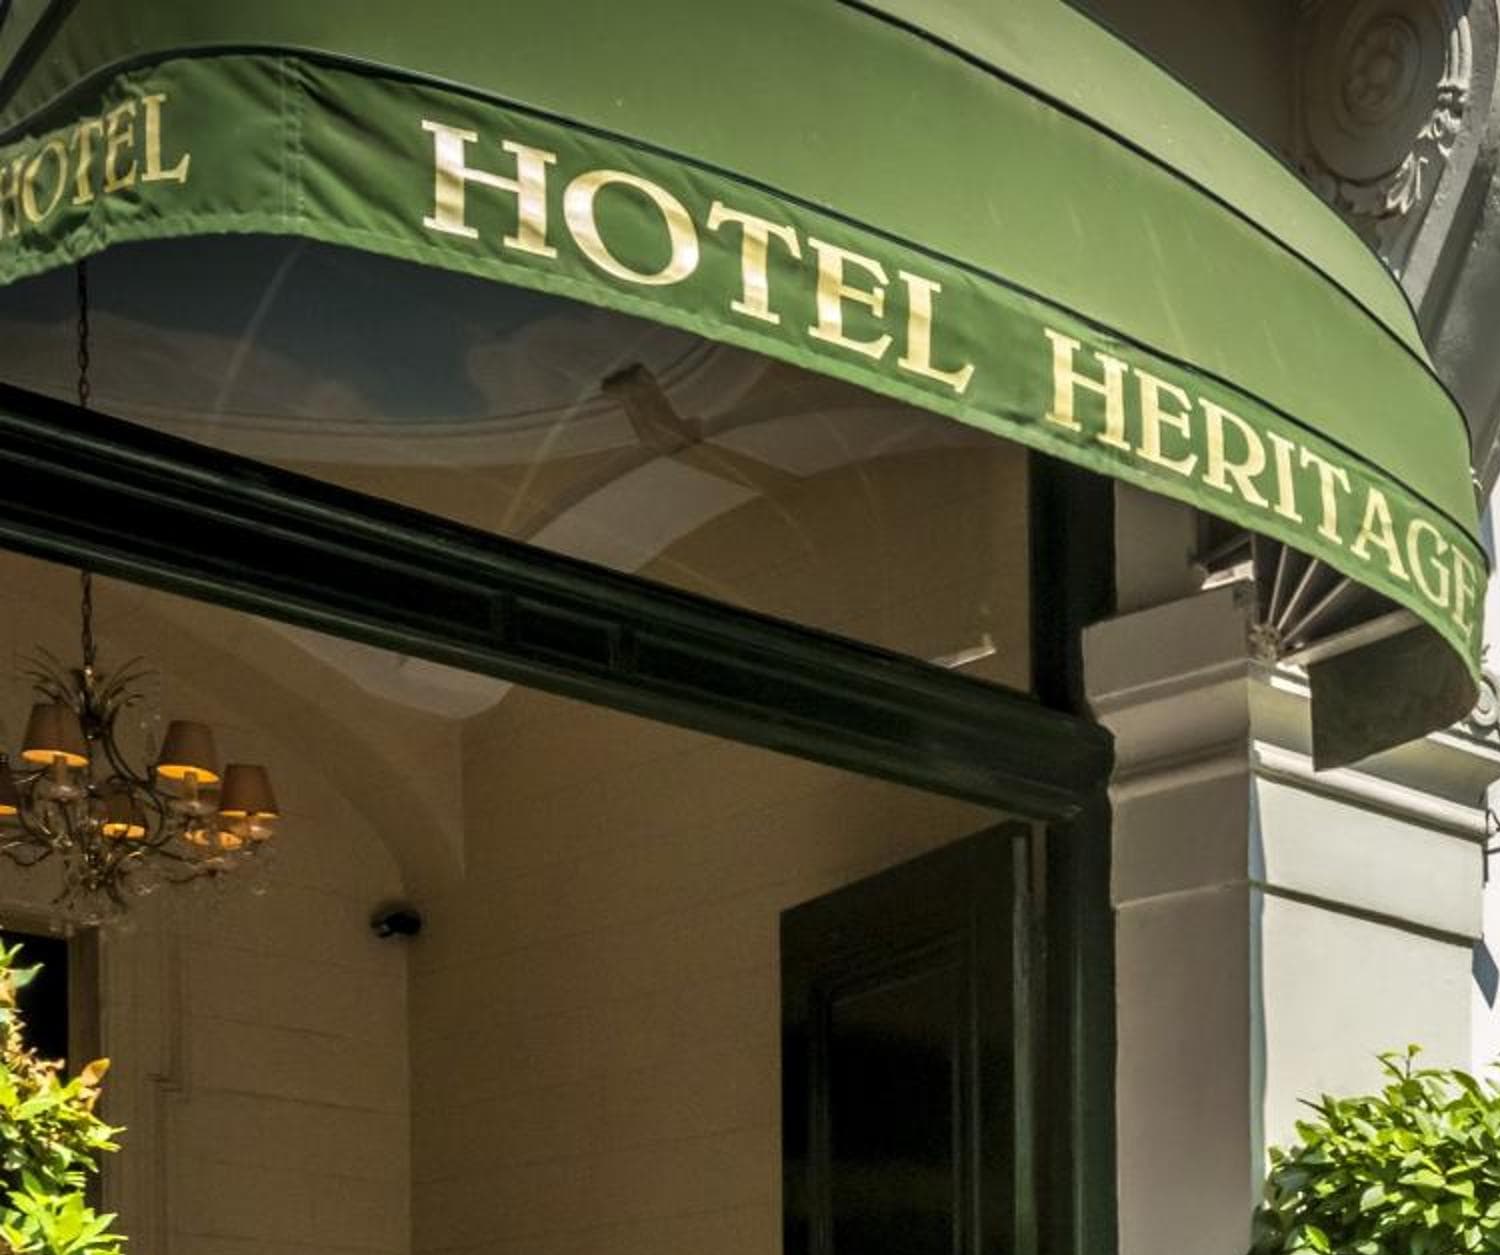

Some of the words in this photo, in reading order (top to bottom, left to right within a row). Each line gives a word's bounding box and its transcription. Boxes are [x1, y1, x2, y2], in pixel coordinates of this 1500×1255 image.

[0, 93, 191, 240] HOTEL
[420, 119, 975, 394] HOTEL
[1045, 327, 1478, 641] HERITAGE
